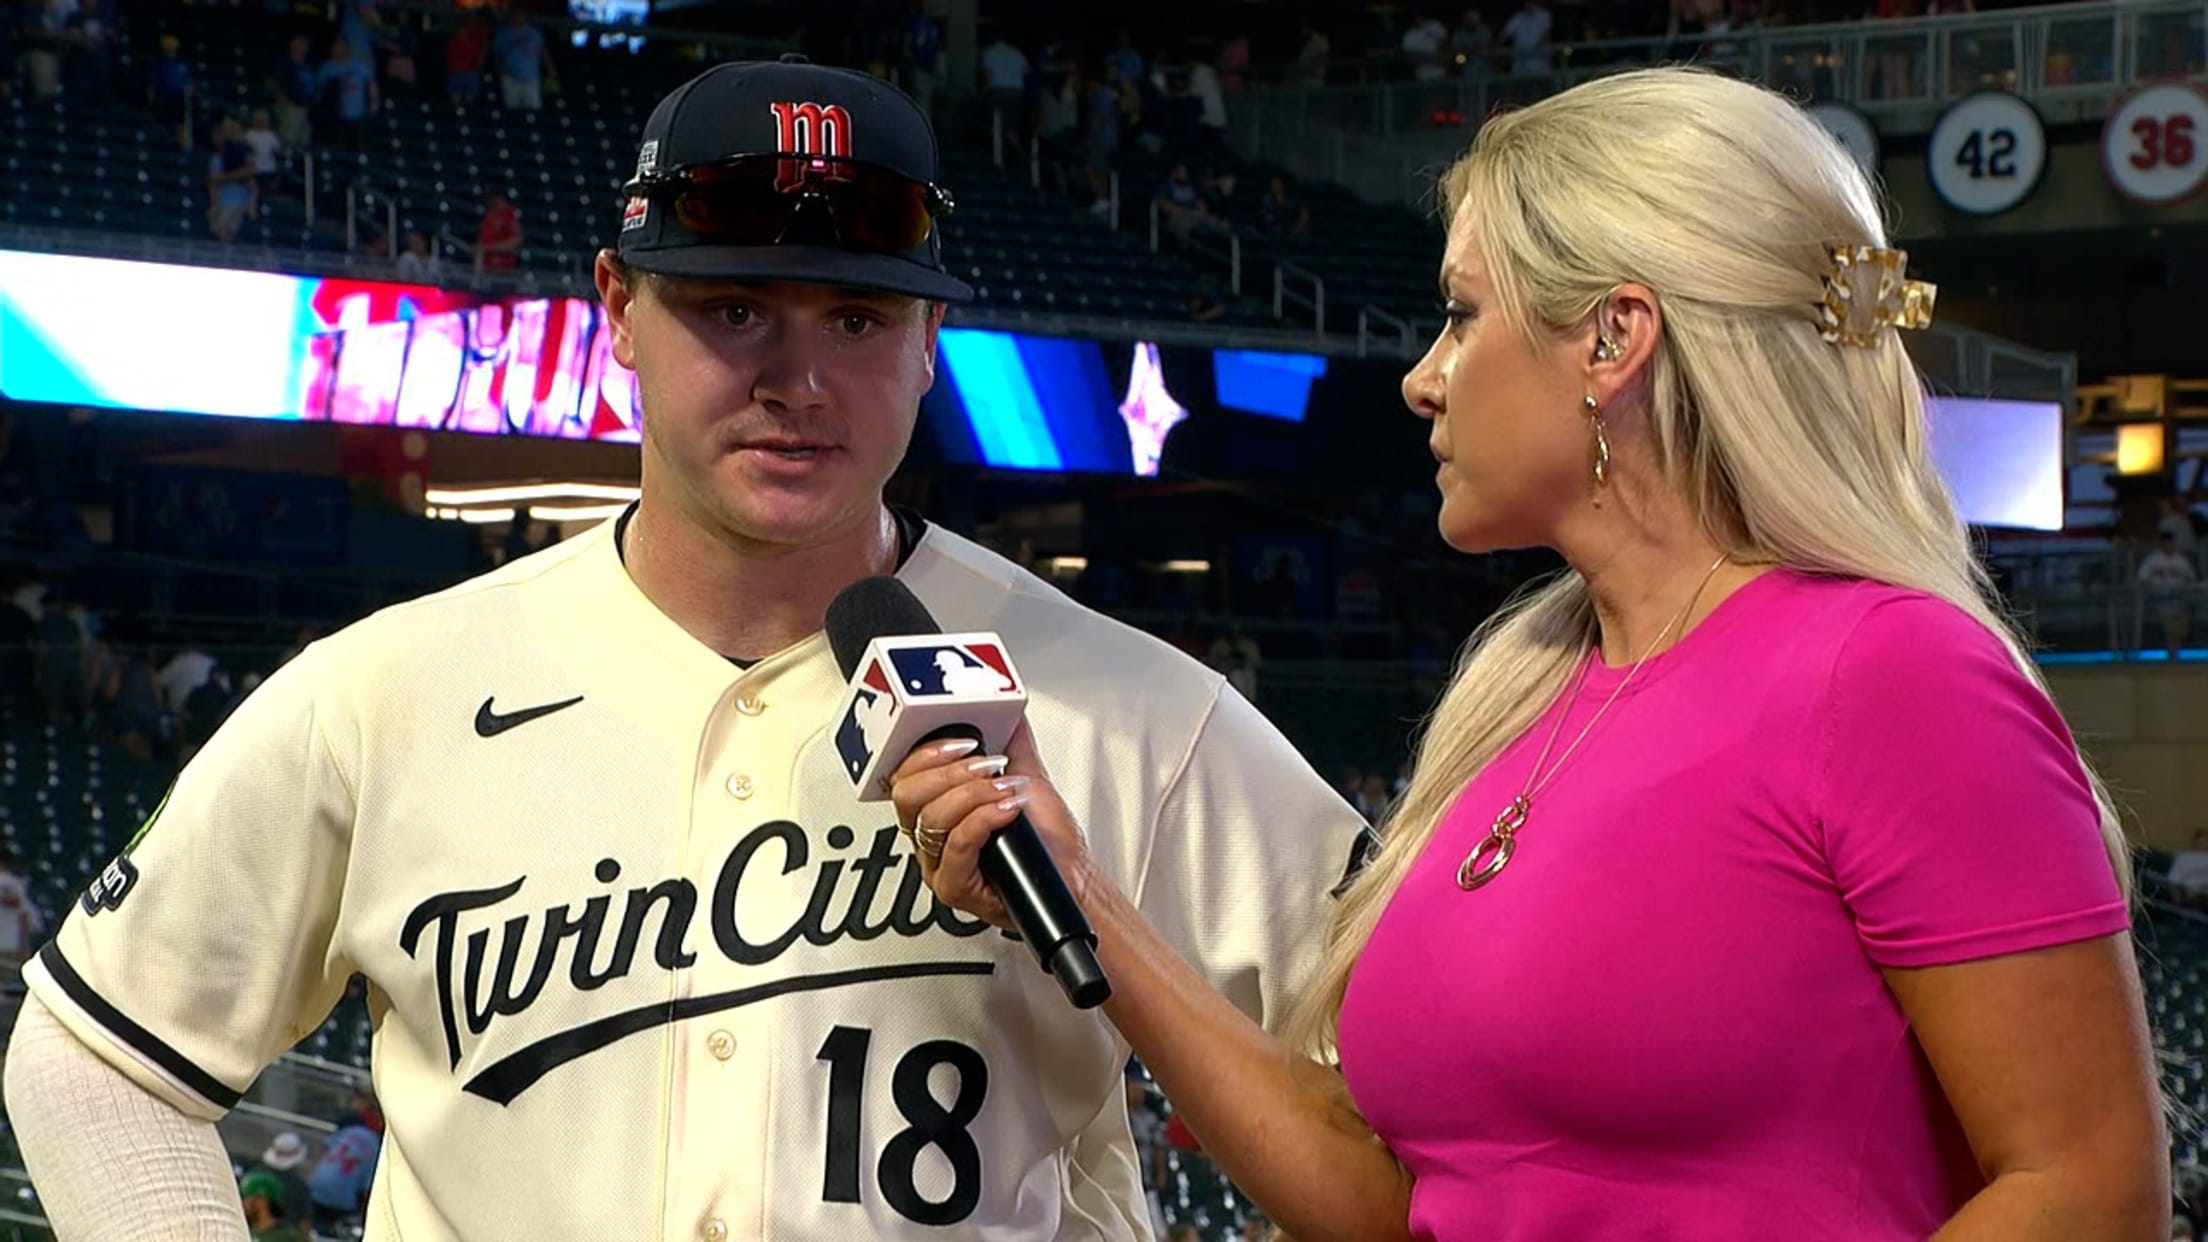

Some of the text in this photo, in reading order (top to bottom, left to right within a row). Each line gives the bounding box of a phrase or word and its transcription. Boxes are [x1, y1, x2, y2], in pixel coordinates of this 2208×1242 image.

[1956, 128, 2016, 179] 42
[2129, 113, 2197, 171] 36
[400, 820, 1023, 1074] Twin Citi
[816, 1025, 988, 1226] 18
